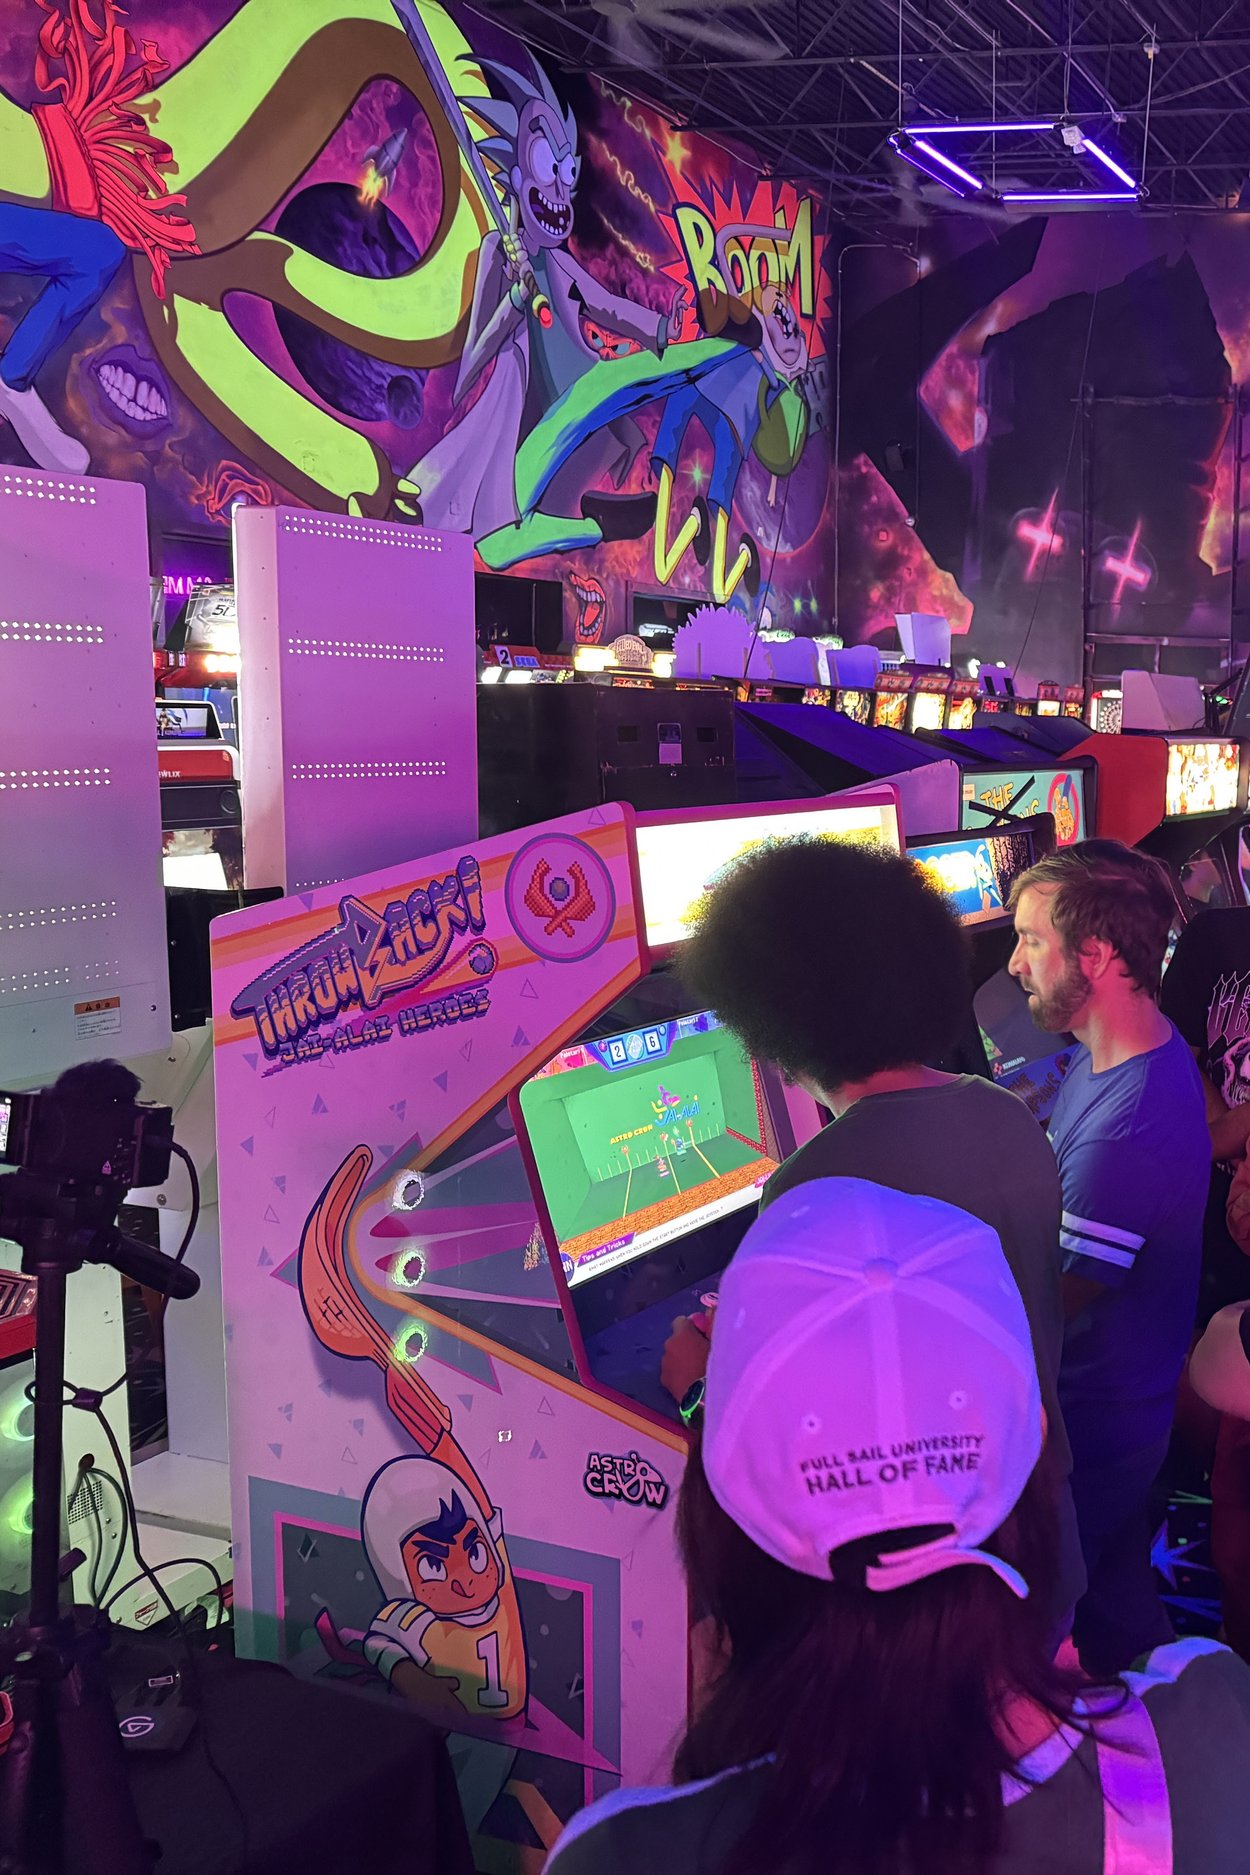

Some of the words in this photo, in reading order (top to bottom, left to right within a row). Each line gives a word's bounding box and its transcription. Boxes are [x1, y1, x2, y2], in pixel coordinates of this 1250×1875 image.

[673, 196, 816, 337] BOOM
[514, 655, 540, 667] SEGA
[980, 782, 1014, 807] THE
[399, 989, 491, 1037] HEROES
[614, 1045, 622, 1058] 2
[650, 1036, 656, 1048] 6
[800, 1456, 844, 1473] FULL
[848, 1446, 888, 1464] SAIL
[890, 1433, 984, 1458] UNIVERSITY
[806, 1467, 872, 1497] HALL
[879, 1459, 918, 1484] OF
[924, 1452, 981, 1476] FAME
[476, 1630, 509, 1708] 1
